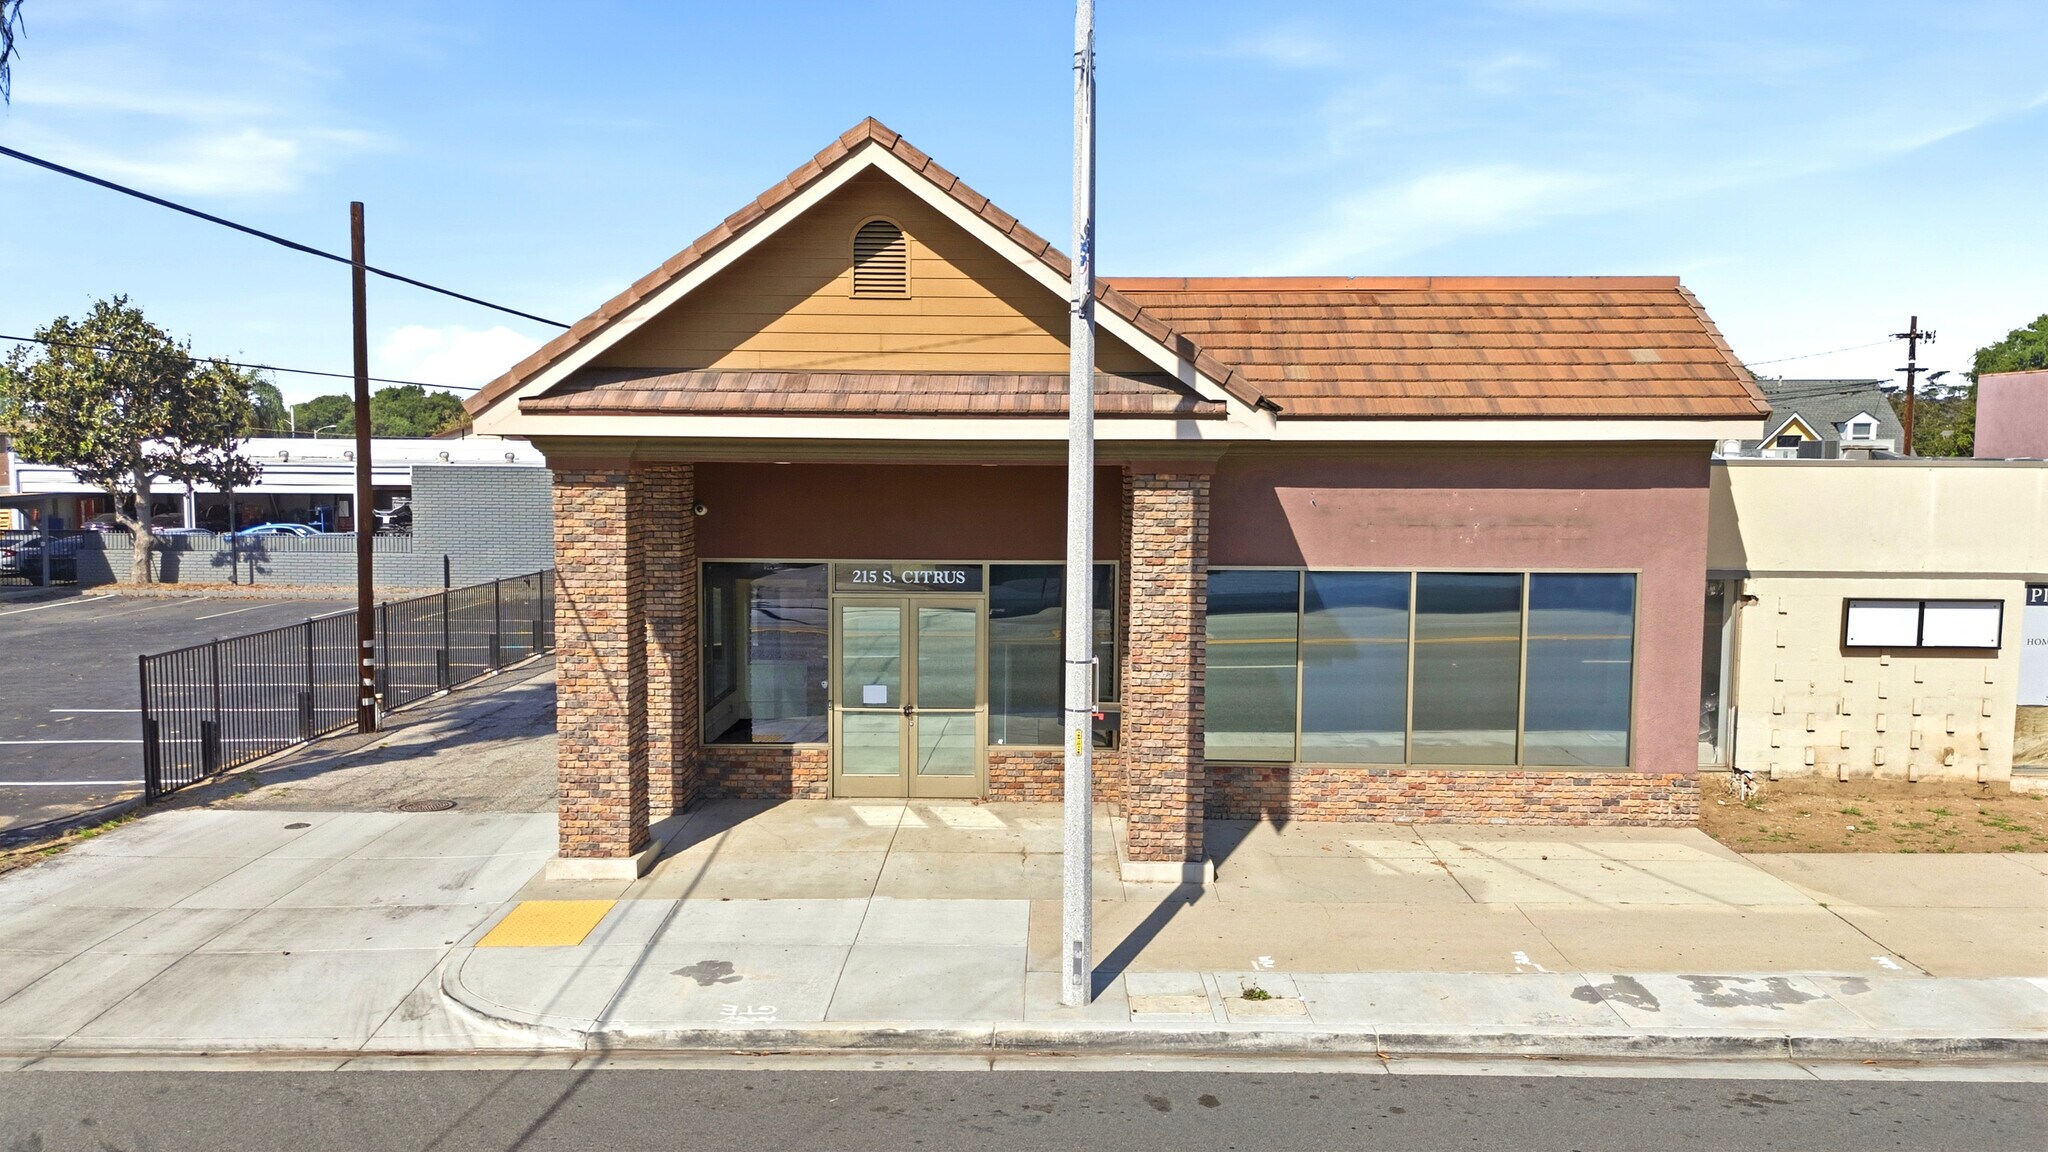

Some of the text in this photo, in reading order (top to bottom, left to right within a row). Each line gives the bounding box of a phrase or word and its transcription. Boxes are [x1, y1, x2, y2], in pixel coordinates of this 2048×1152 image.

[852, 570, 966, 584] 215 S. CITRUS
